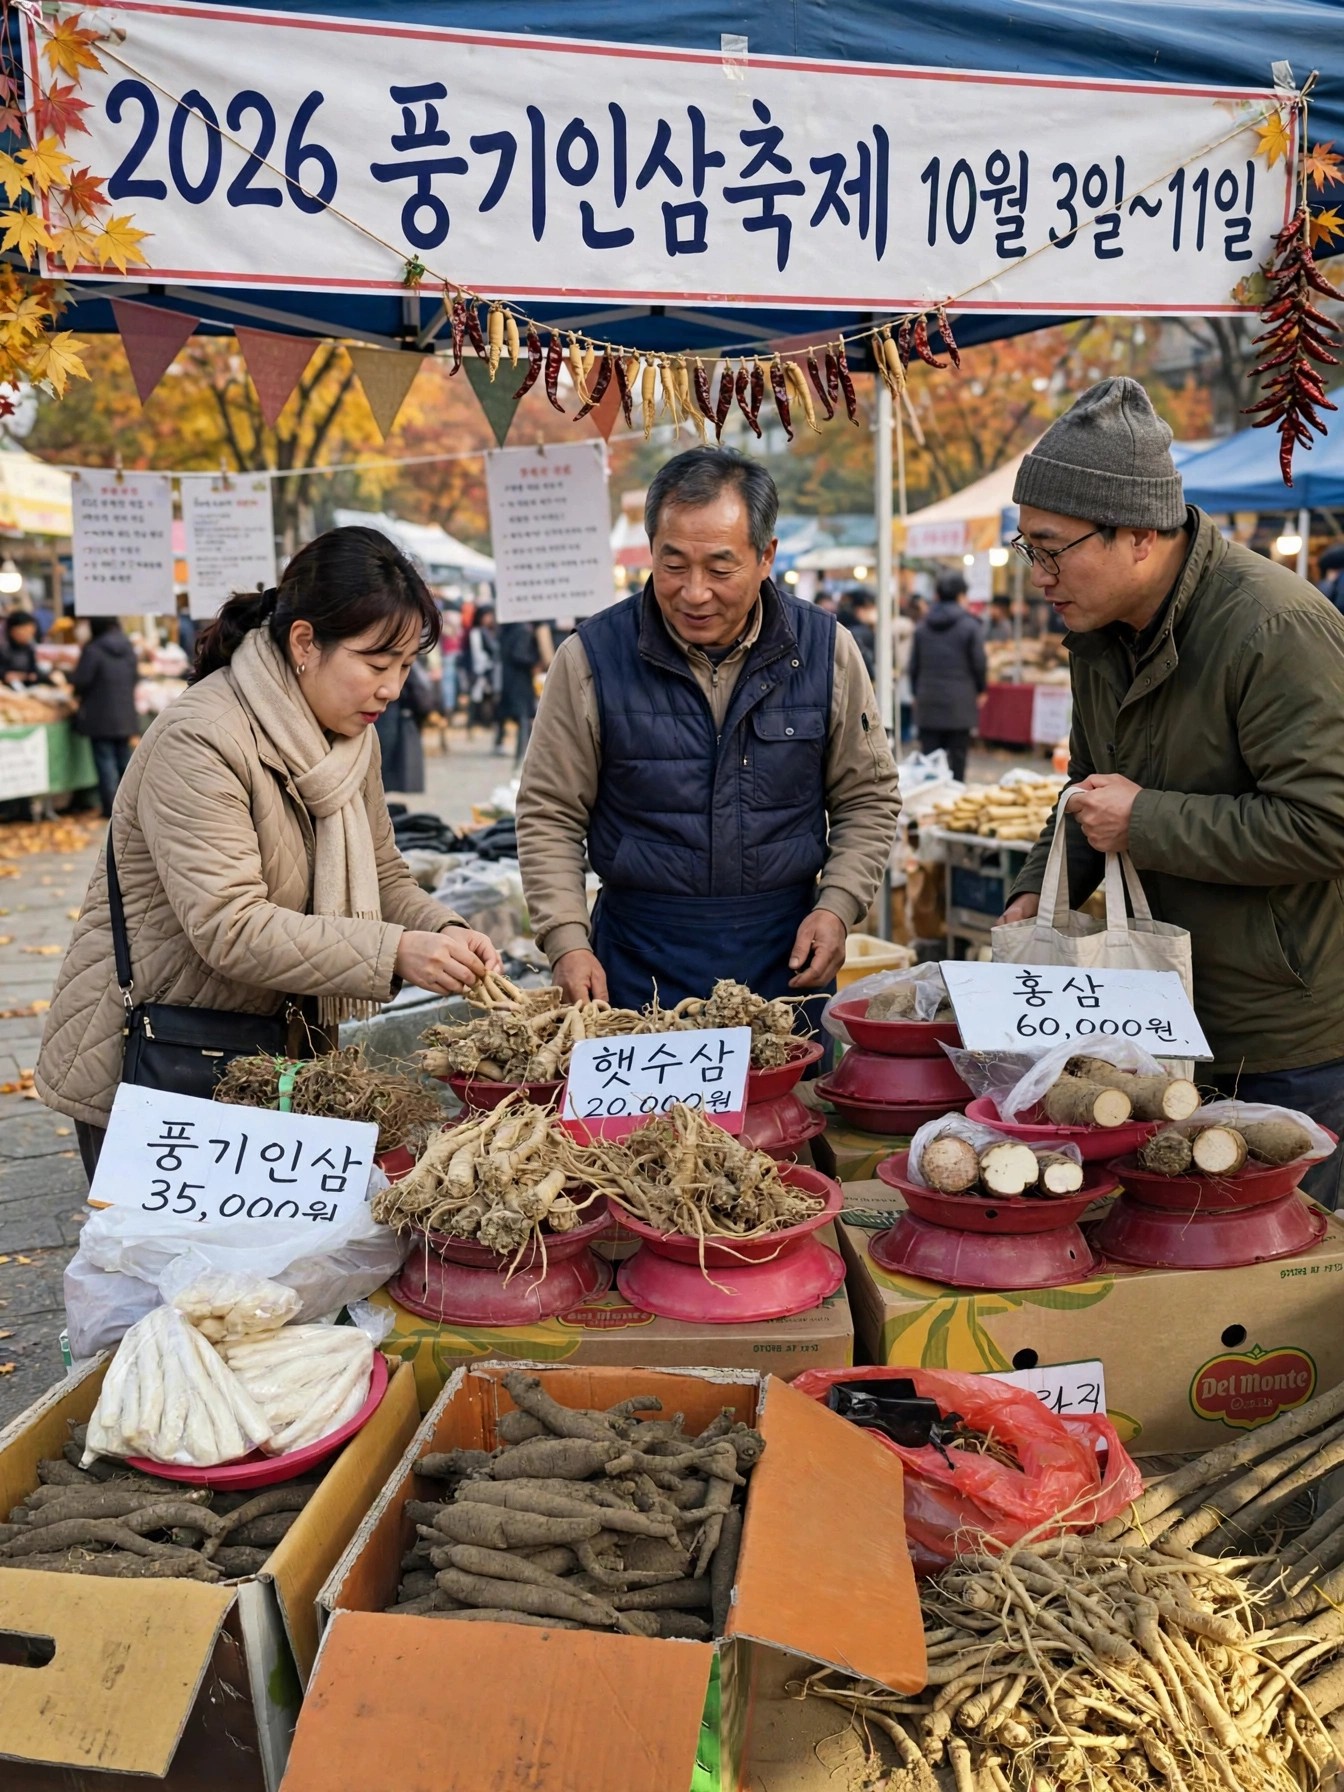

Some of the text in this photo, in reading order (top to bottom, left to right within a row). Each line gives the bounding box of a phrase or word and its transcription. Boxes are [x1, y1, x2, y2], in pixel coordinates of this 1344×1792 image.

[105, 79, 337, 214] 2026
[369, 81, 889, 272] 풍기인삼축제
[921, 149, 1028, 259] 10월
[592, 1039, 735, 1089] 햇수삼
[146, 1120, 363, 1193] 풍기인삼
[1202, 1369, 1308, 1399] Del Monte
